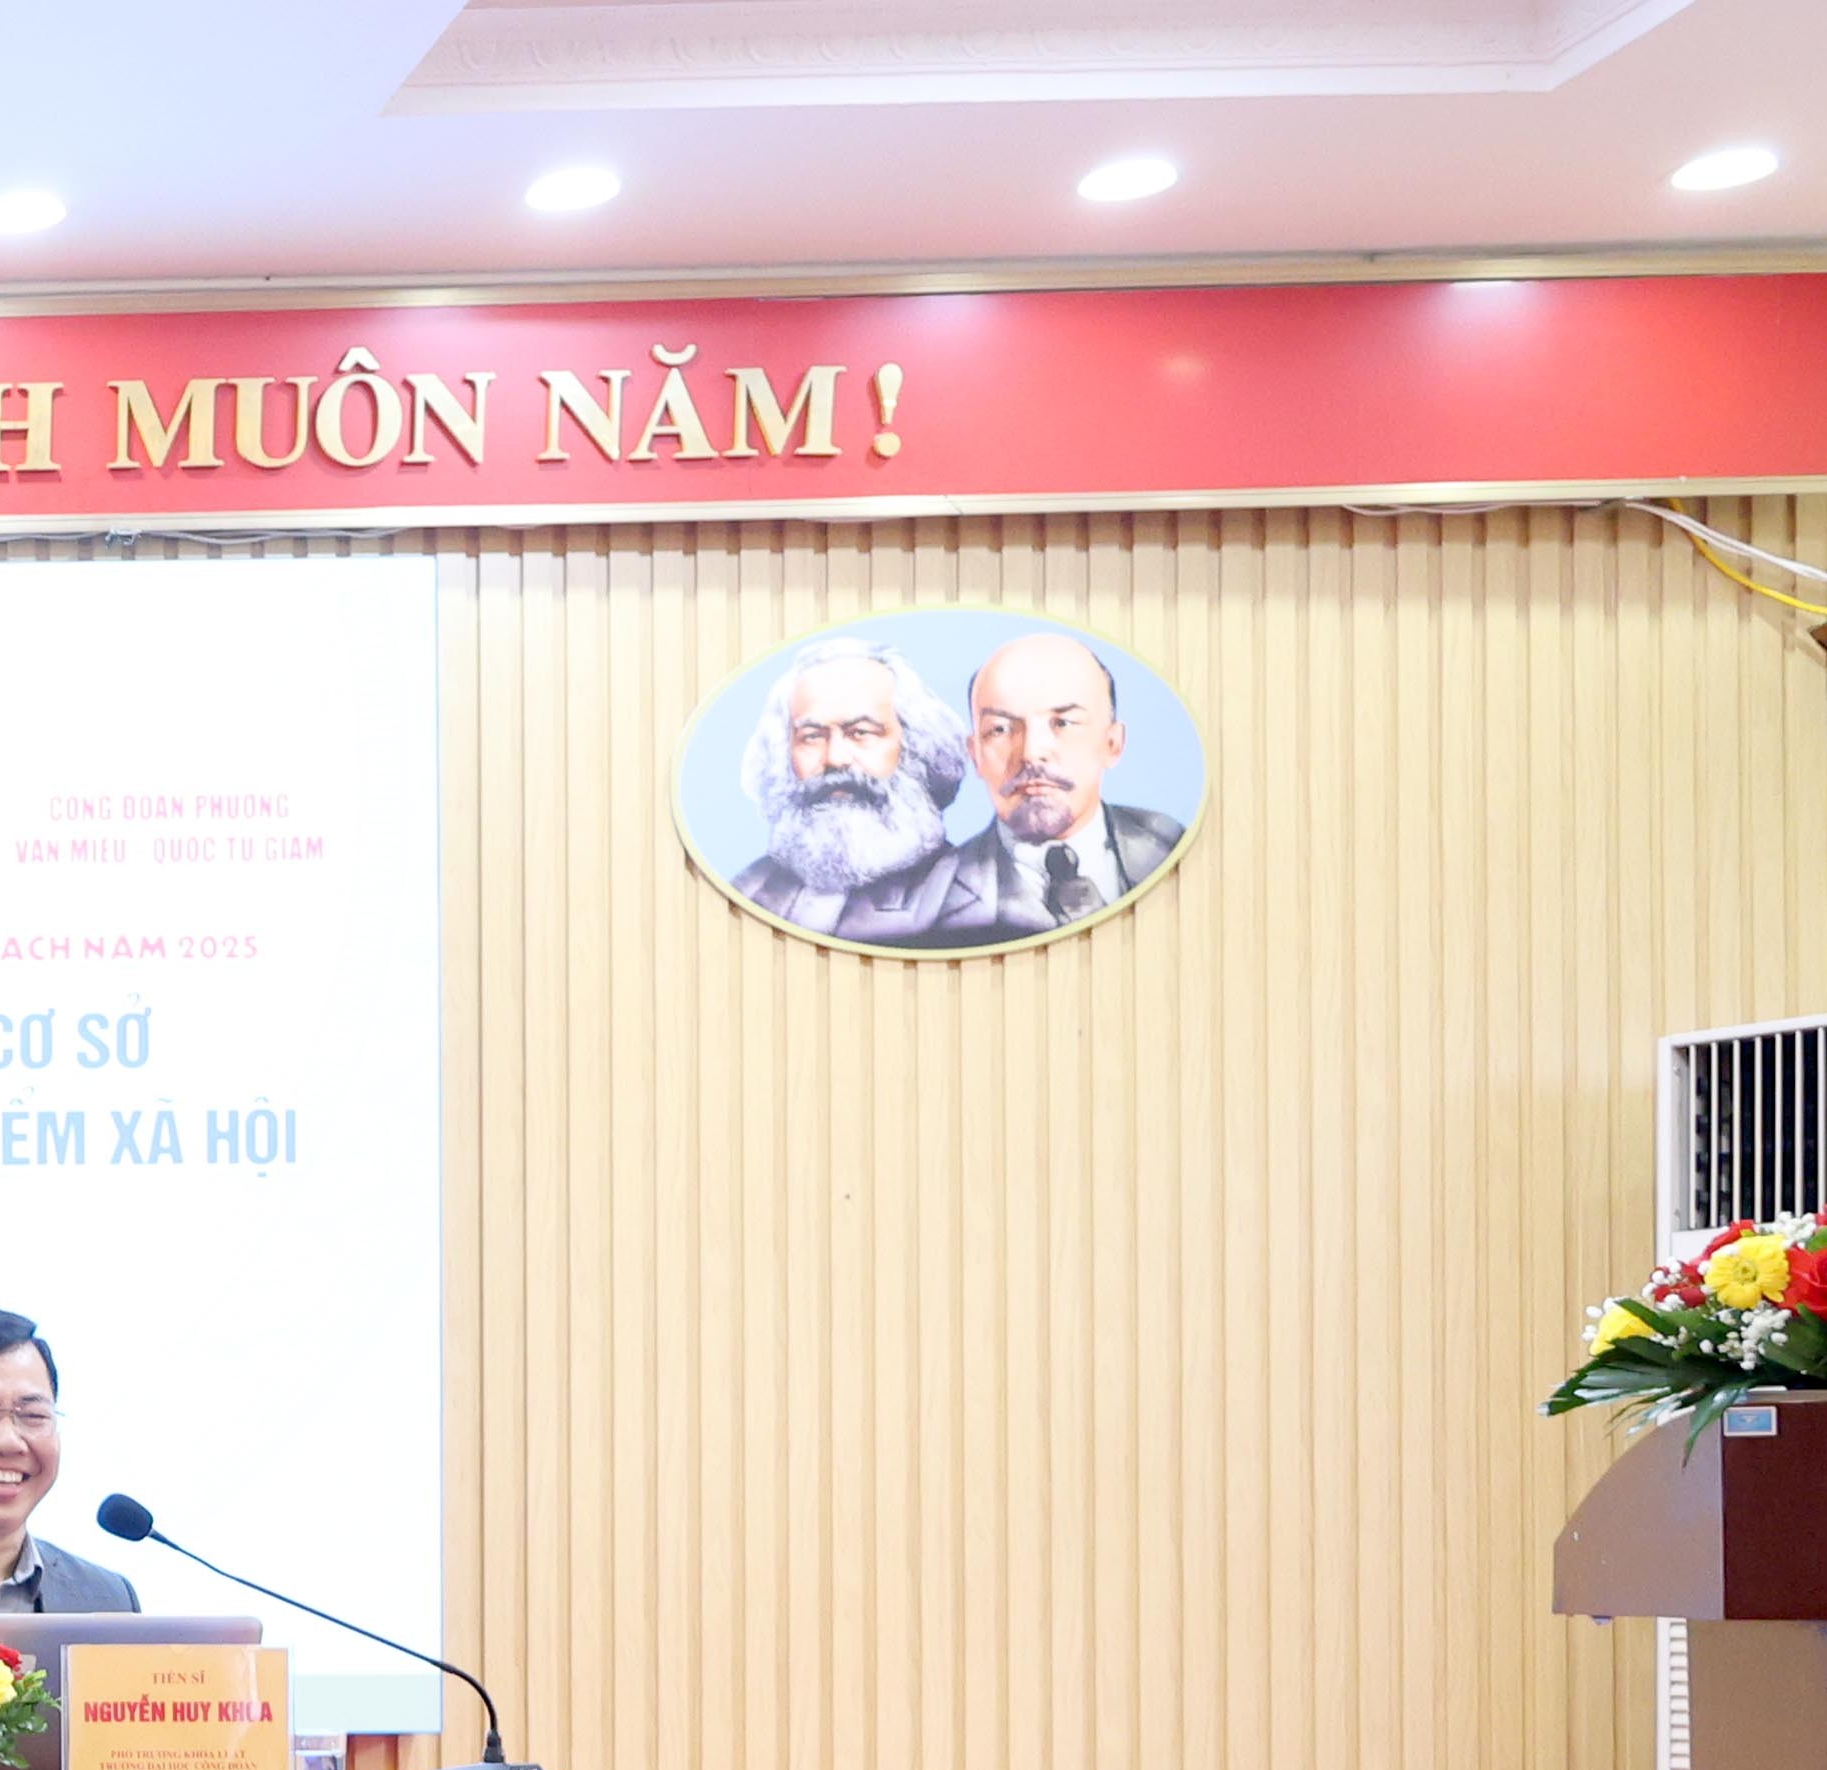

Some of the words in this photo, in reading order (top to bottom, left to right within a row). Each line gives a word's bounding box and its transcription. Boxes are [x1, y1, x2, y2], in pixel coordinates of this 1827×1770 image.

[108, 348, 496, 473] MUÔN
[538, 344, 846, 465] NĂM
[178, 934, 258, 960] 2025
[76, 991, 152, 1069] SỞ
[110, 1096, 184, 1165] XÃ
[206, 1094, 297, 1178] HỘI
[84, 1694, 166, 1722] NGUYỄN
[173, 1701, 211, 1722] HUY
